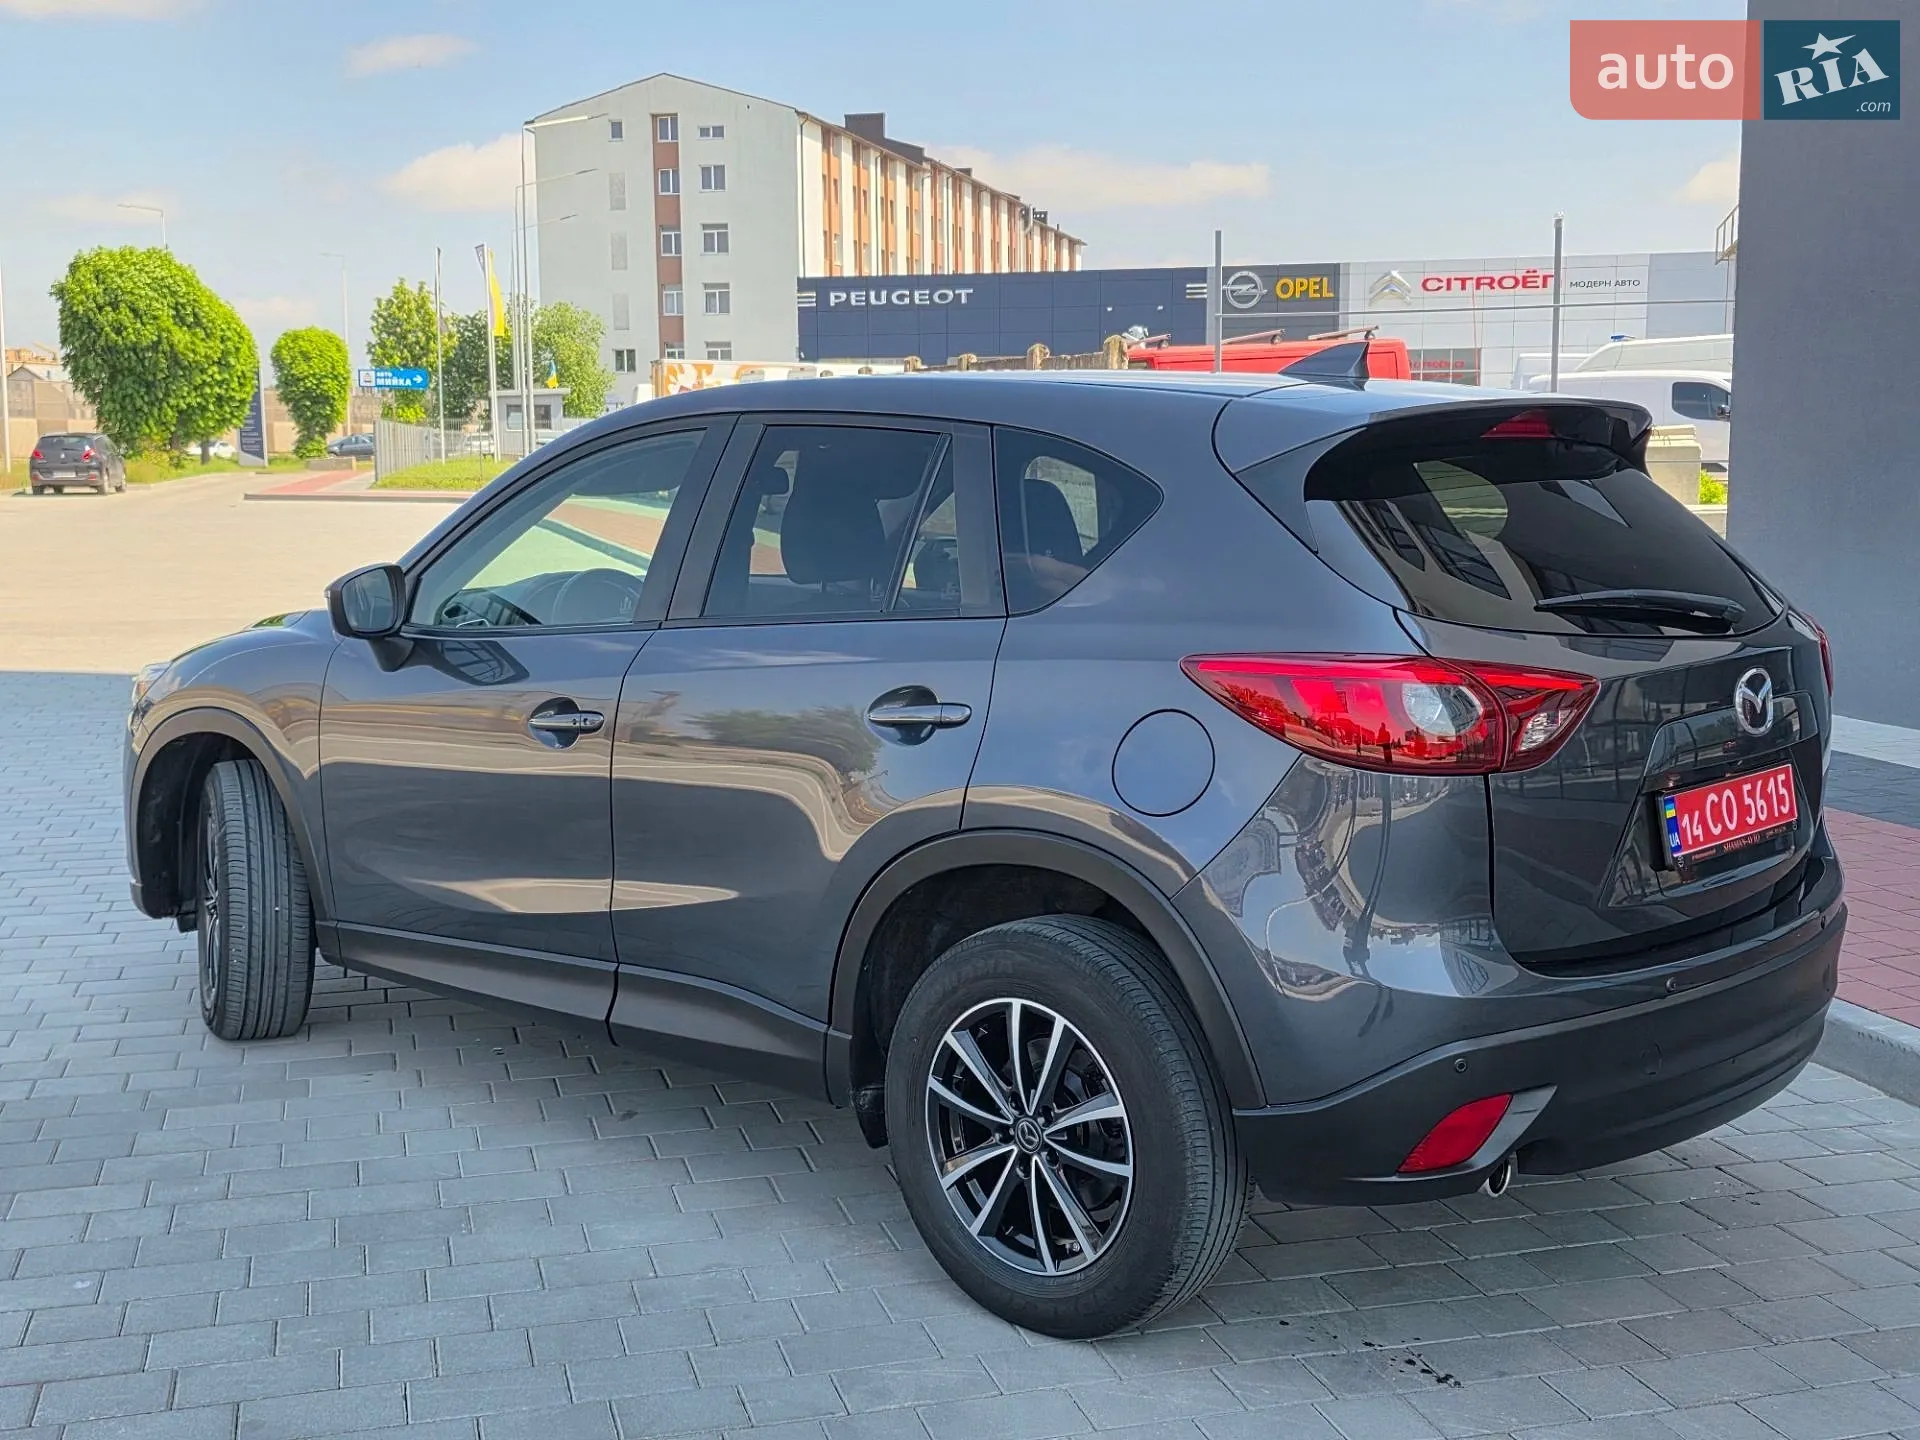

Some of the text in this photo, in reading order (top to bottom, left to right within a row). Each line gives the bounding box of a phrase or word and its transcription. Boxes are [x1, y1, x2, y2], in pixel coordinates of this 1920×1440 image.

[1275, 277, 1335, 299] OPEL
[1569, 279, 1641, 289] МОДЕРН АВТО
[829, 288, 974, 307] PEUGEOT
[1742, 773, 1790, 825] 5615
[1669, 831, 1681, 848] UA
